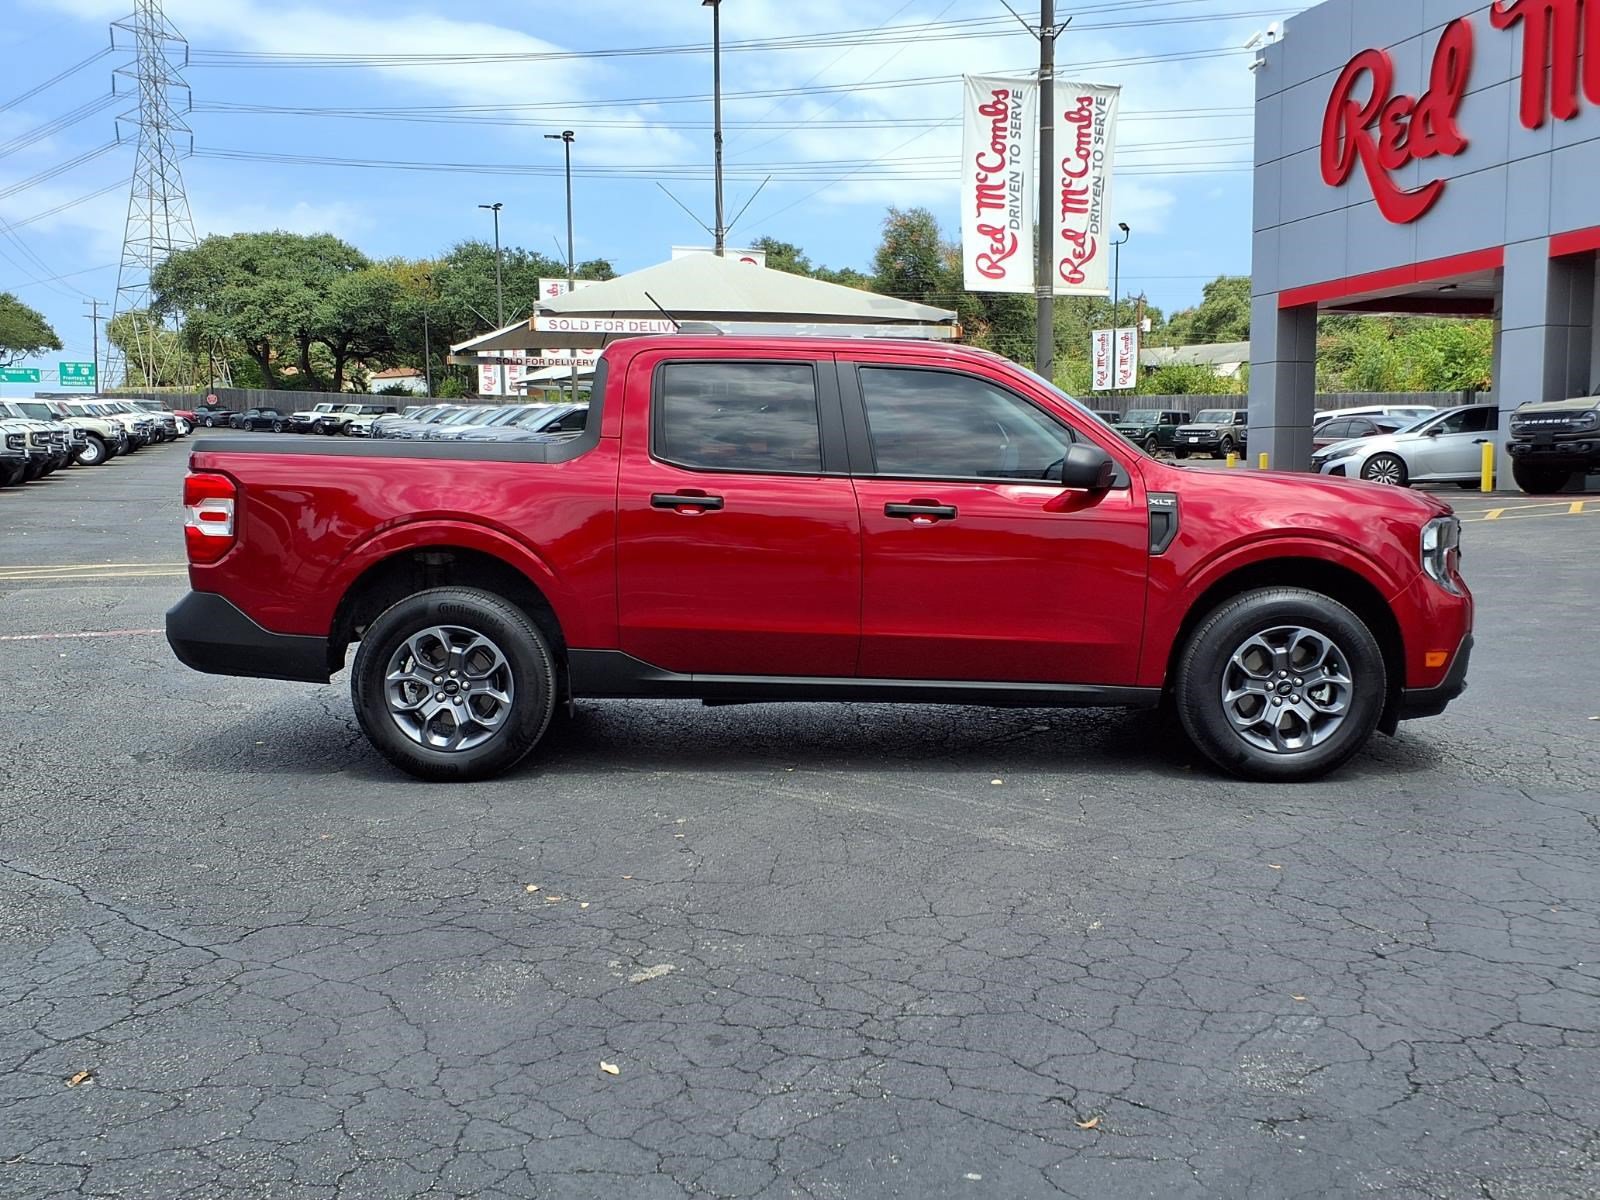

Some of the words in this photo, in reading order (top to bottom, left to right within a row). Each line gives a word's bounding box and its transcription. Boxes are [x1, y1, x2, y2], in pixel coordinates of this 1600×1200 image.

[1009, 89, 1023, 140] SERVE
[1093, 96, 1107, 145] SERVE
[1320, 17, 1473, 224] Red
[975, 88, 1010, 219] McCombs
[1009, 144, 1021, 167] TO
[1061, 95, 1094, 223] McCombs
[1092, 150, 1104, 172] TO
[1009, 171, 1021, 230] DRIVEN
[1089, 176, 1102, 235] DRIVEN
[975, 224, 1018, 280] Red
[1059, 228, 1097, 284] Red
[548, 319, 590, 331] SOLD
[594, 320, 624, 332] FOR
[495, 357, 523, 366] SOLD
[525, 358, 545, 366] FOR
[548, 358, 595, 366] DELIVERY
[1096, 370, 1108, 386] Red
[1118, 369, 1132, 385] Red
[1149, 498, 1176, 506] XLT
